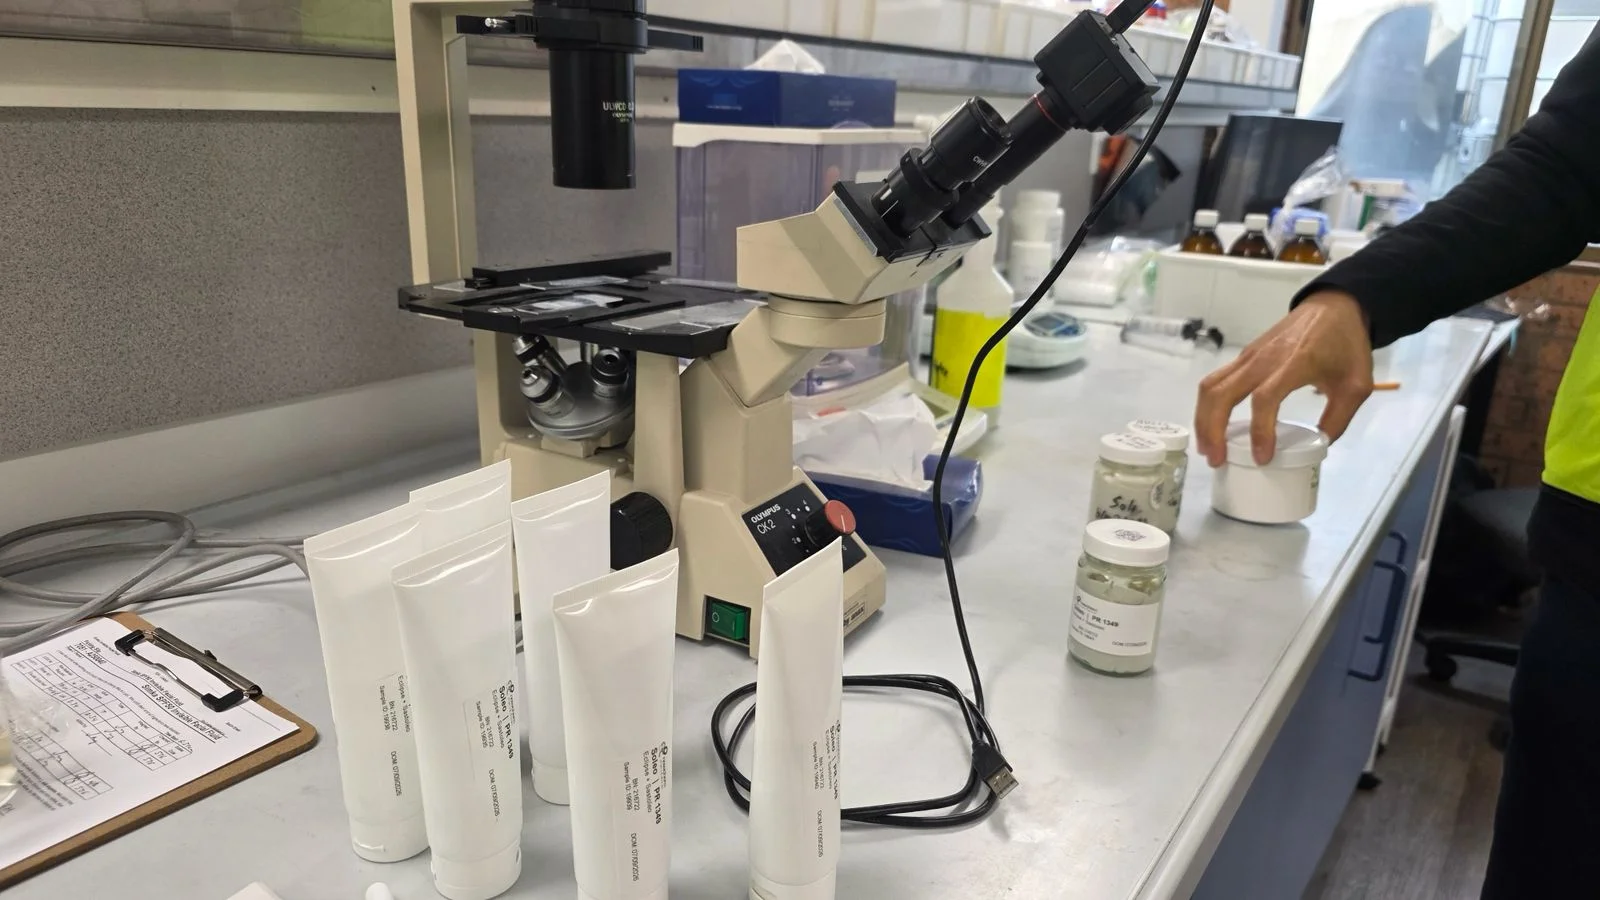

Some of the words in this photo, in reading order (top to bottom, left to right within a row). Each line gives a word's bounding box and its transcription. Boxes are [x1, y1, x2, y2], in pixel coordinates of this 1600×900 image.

[751, 503, 781, 524] OLYMPUS
[1103, 618, 1119, 628] 1349
[475, 700, 484, 722] Sample
[491, 690, 500, 714] Eclipse
[498, 685, 508, 712] Soleo
[503, 723, 512, 738] PR
[171, 706, 194, 723] Invisible
[191, 720, 208, 732] Facial
[205, 728, 223, 741] Fluid
[623, 761, 631, 783] Sample
[642, 750, 650, 777] Eclipse
[650, 747, 659, 775] Soleo
[654, 787, 661, 802] PR
